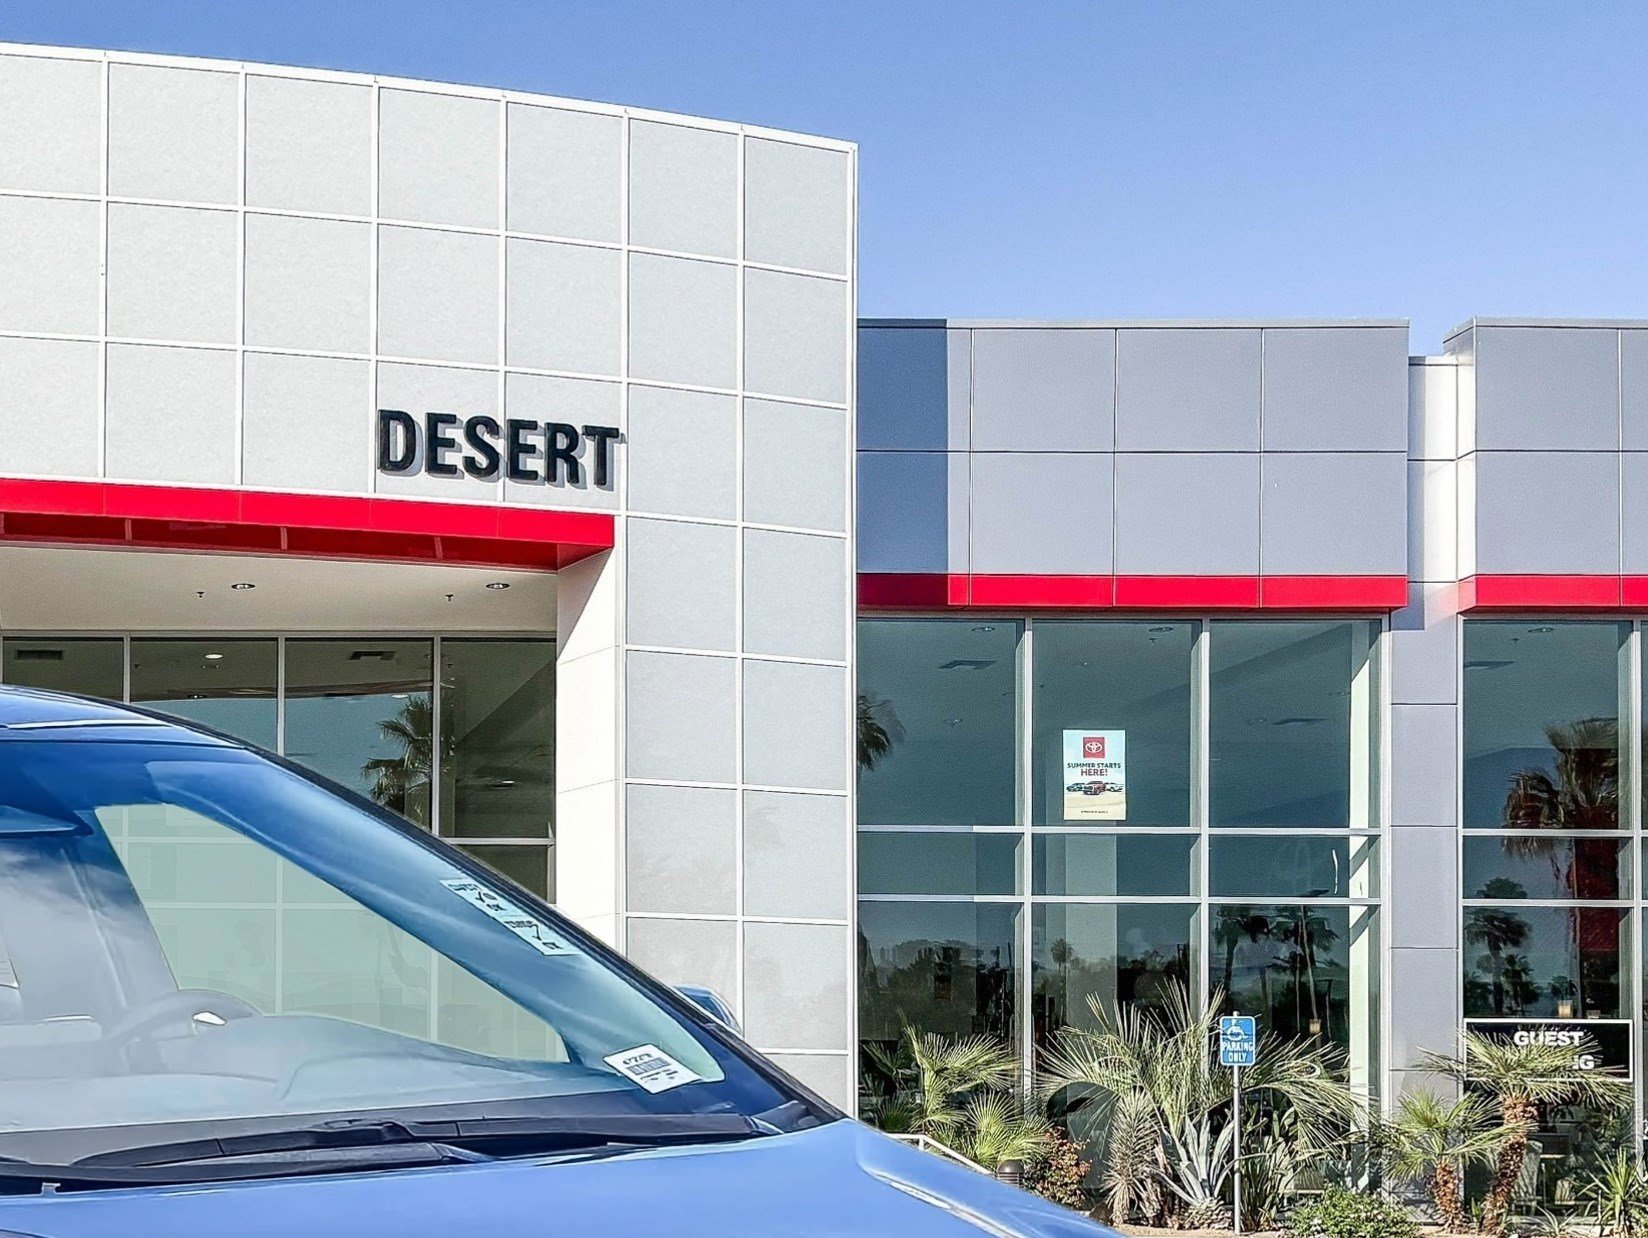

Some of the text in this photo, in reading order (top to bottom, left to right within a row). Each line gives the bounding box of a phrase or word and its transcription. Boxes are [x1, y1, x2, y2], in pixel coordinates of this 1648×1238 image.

[377, 409, 620, 486] DESERT
[1514, 1031, 1584, 1046] GUEST
[1222, 1041, 1254, 1051] PARKING
[1228, 1052, 1247, 1062] ONLY
